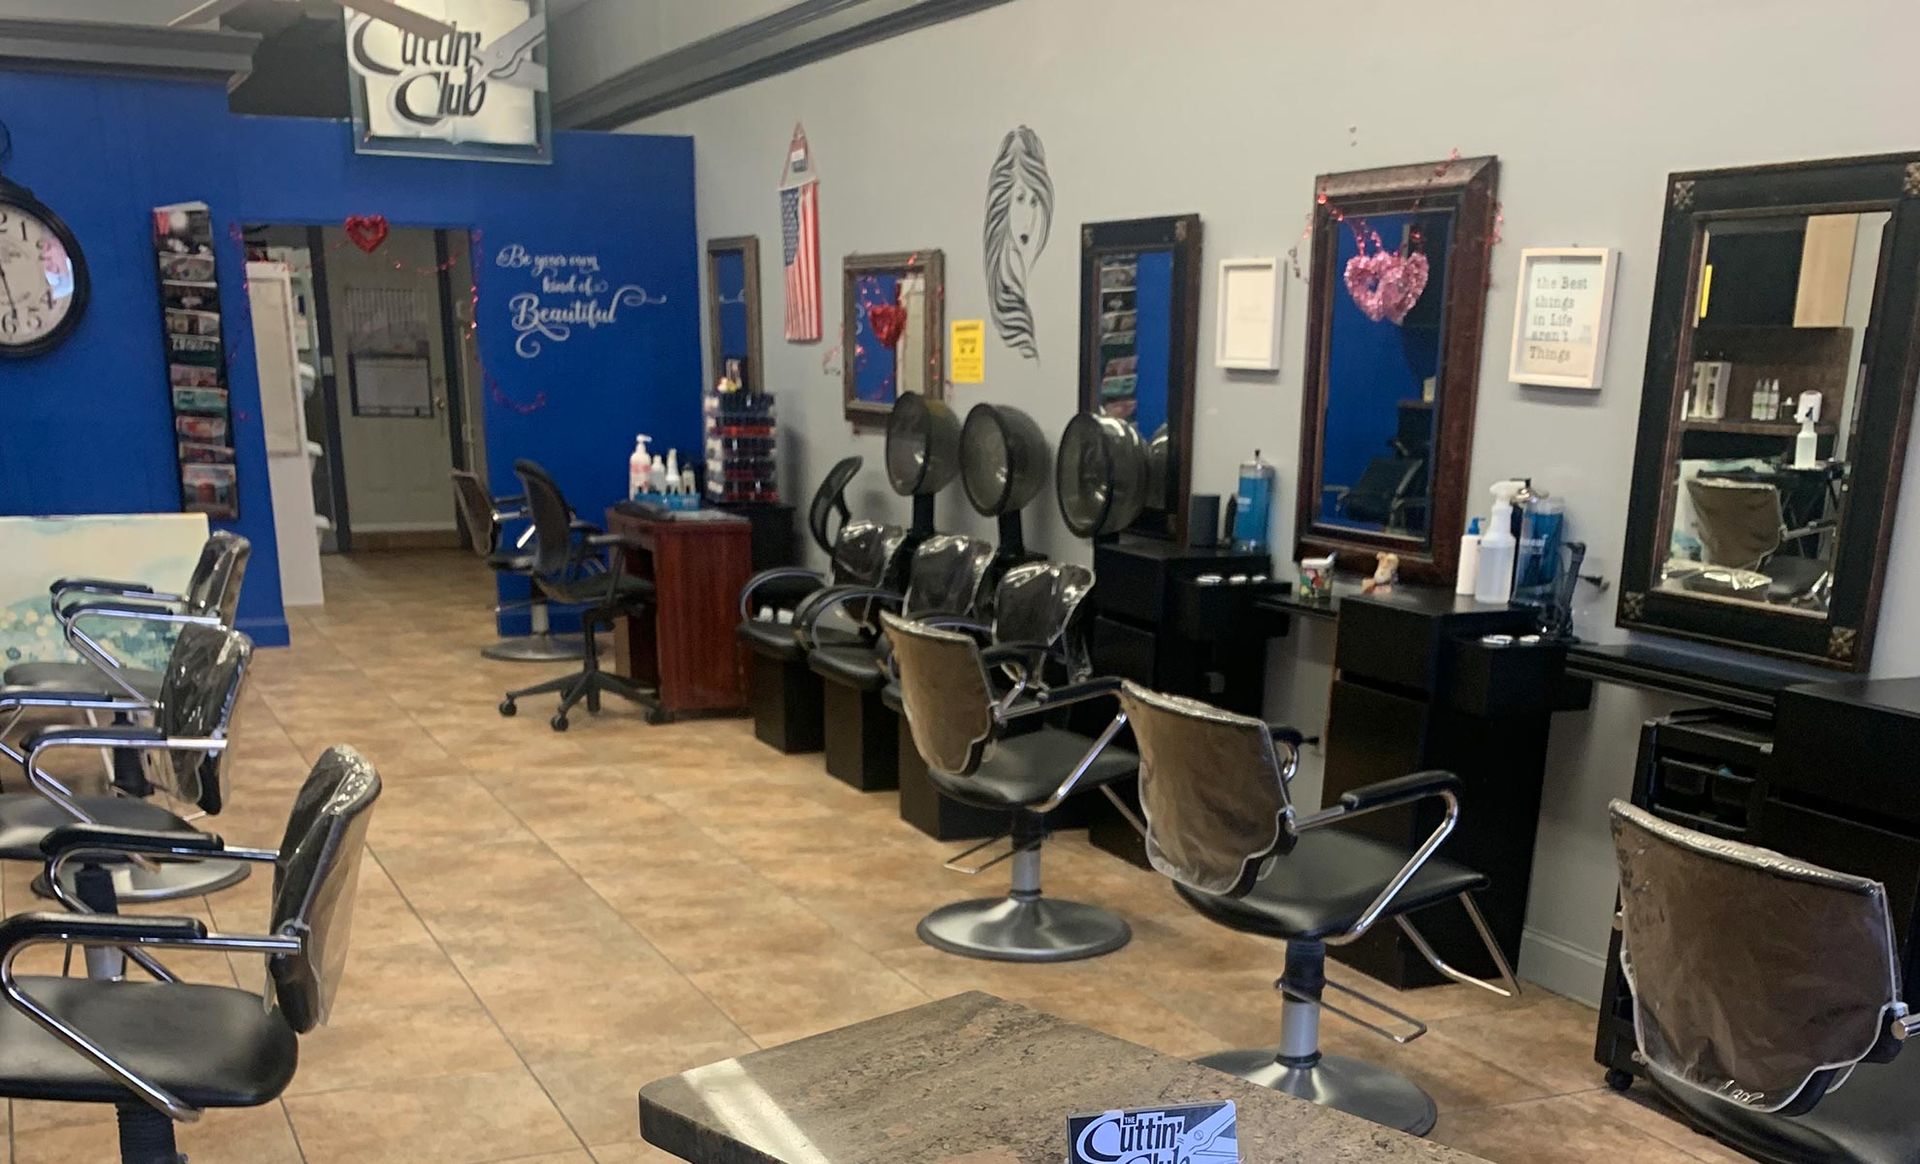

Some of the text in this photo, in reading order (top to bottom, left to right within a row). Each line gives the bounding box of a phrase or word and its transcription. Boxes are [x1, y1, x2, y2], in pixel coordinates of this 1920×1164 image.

[394, 65, 487, 126] Club
[496, 244, 532, 268] Be
[531, 254, 567, 277] your
[542, 274, 577, 294] kind
[1536, 276, 1588, 289] the Best
[1535, 296, 1575, 311] things
[2, 312, 17, 335] 6
[1533, 314, 1573, 327] in Life
[1529, 345, 1571, 364] Things
[1124, 1116, 1136, 1124] THE
[1084, 1115, 1182, 1162] Cuttin'
